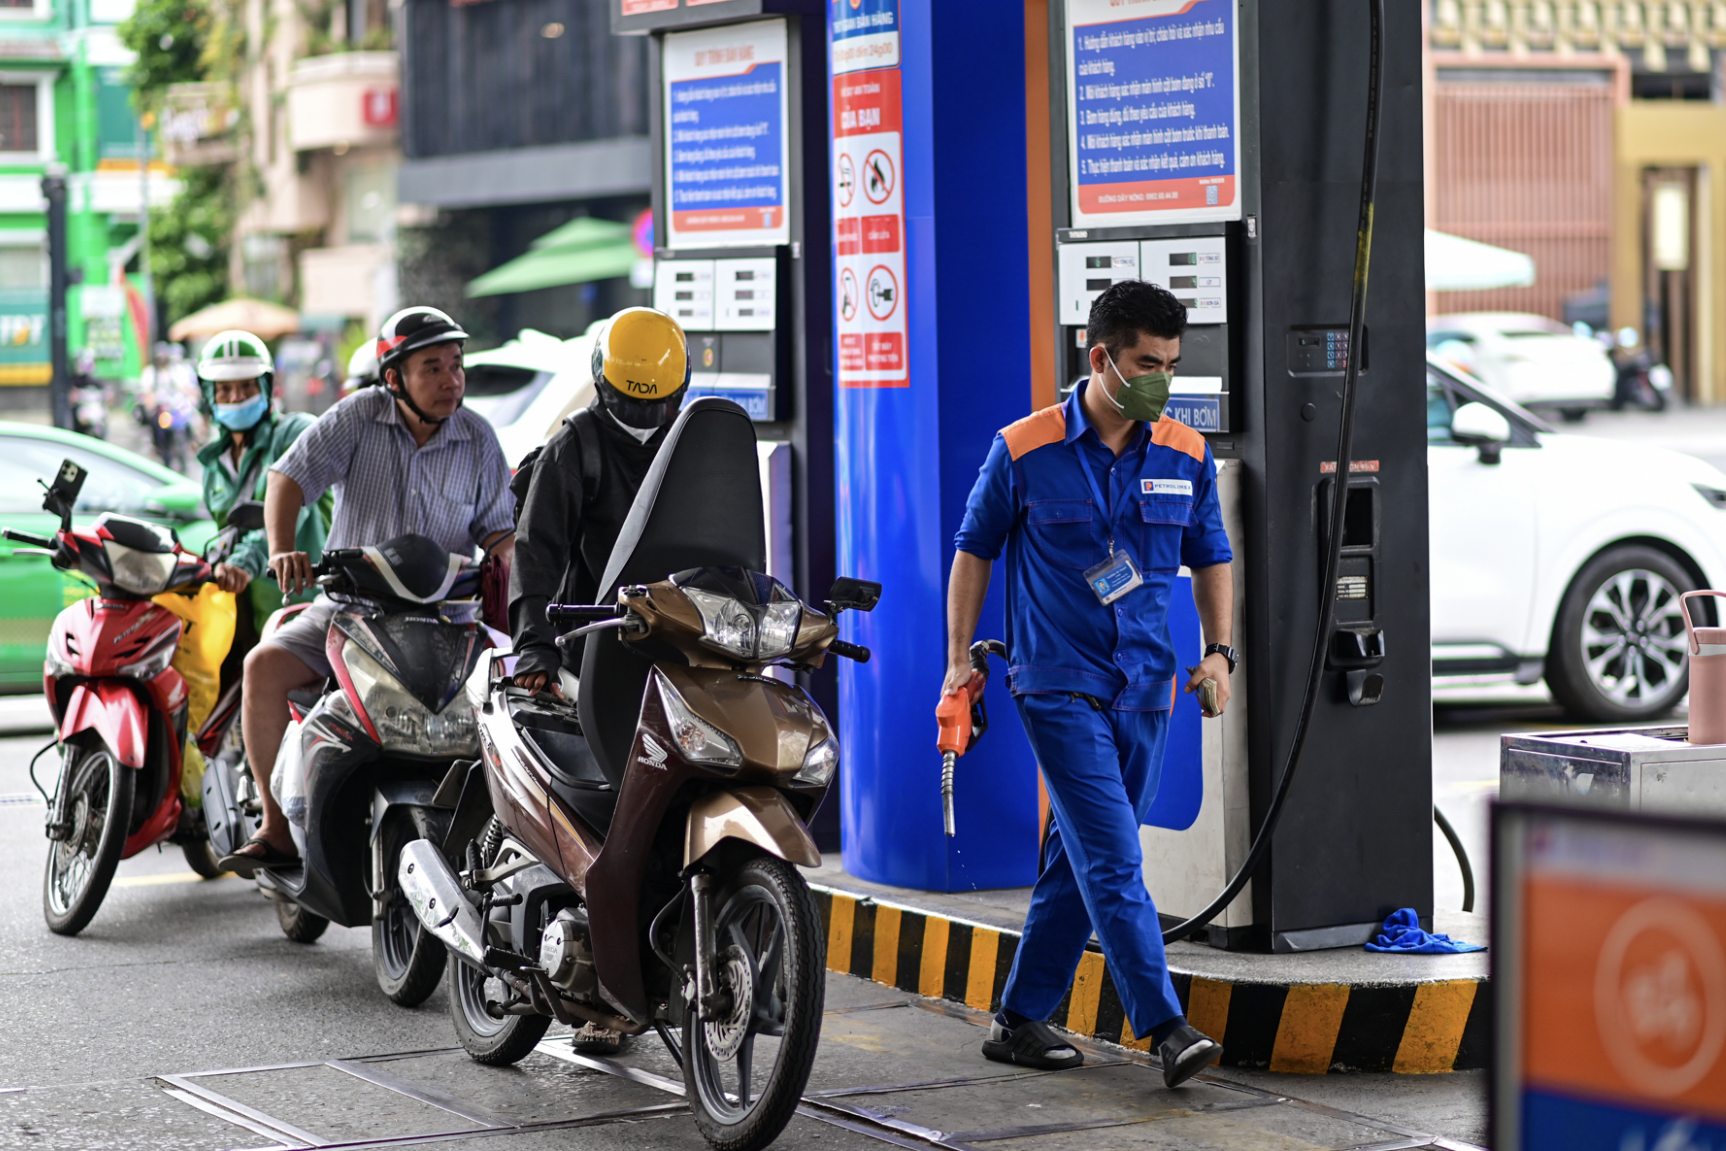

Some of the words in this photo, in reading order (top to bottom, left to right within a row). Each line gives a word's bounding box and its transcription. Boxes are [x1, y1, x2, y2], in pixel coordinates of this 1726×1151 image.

[858, 107, 880, 130] BẠN
[1174, 407, 1191, 426] KHI
[1193, 406, 1216, 428] BƠM
[637, 756, 668, 771] HONDA
